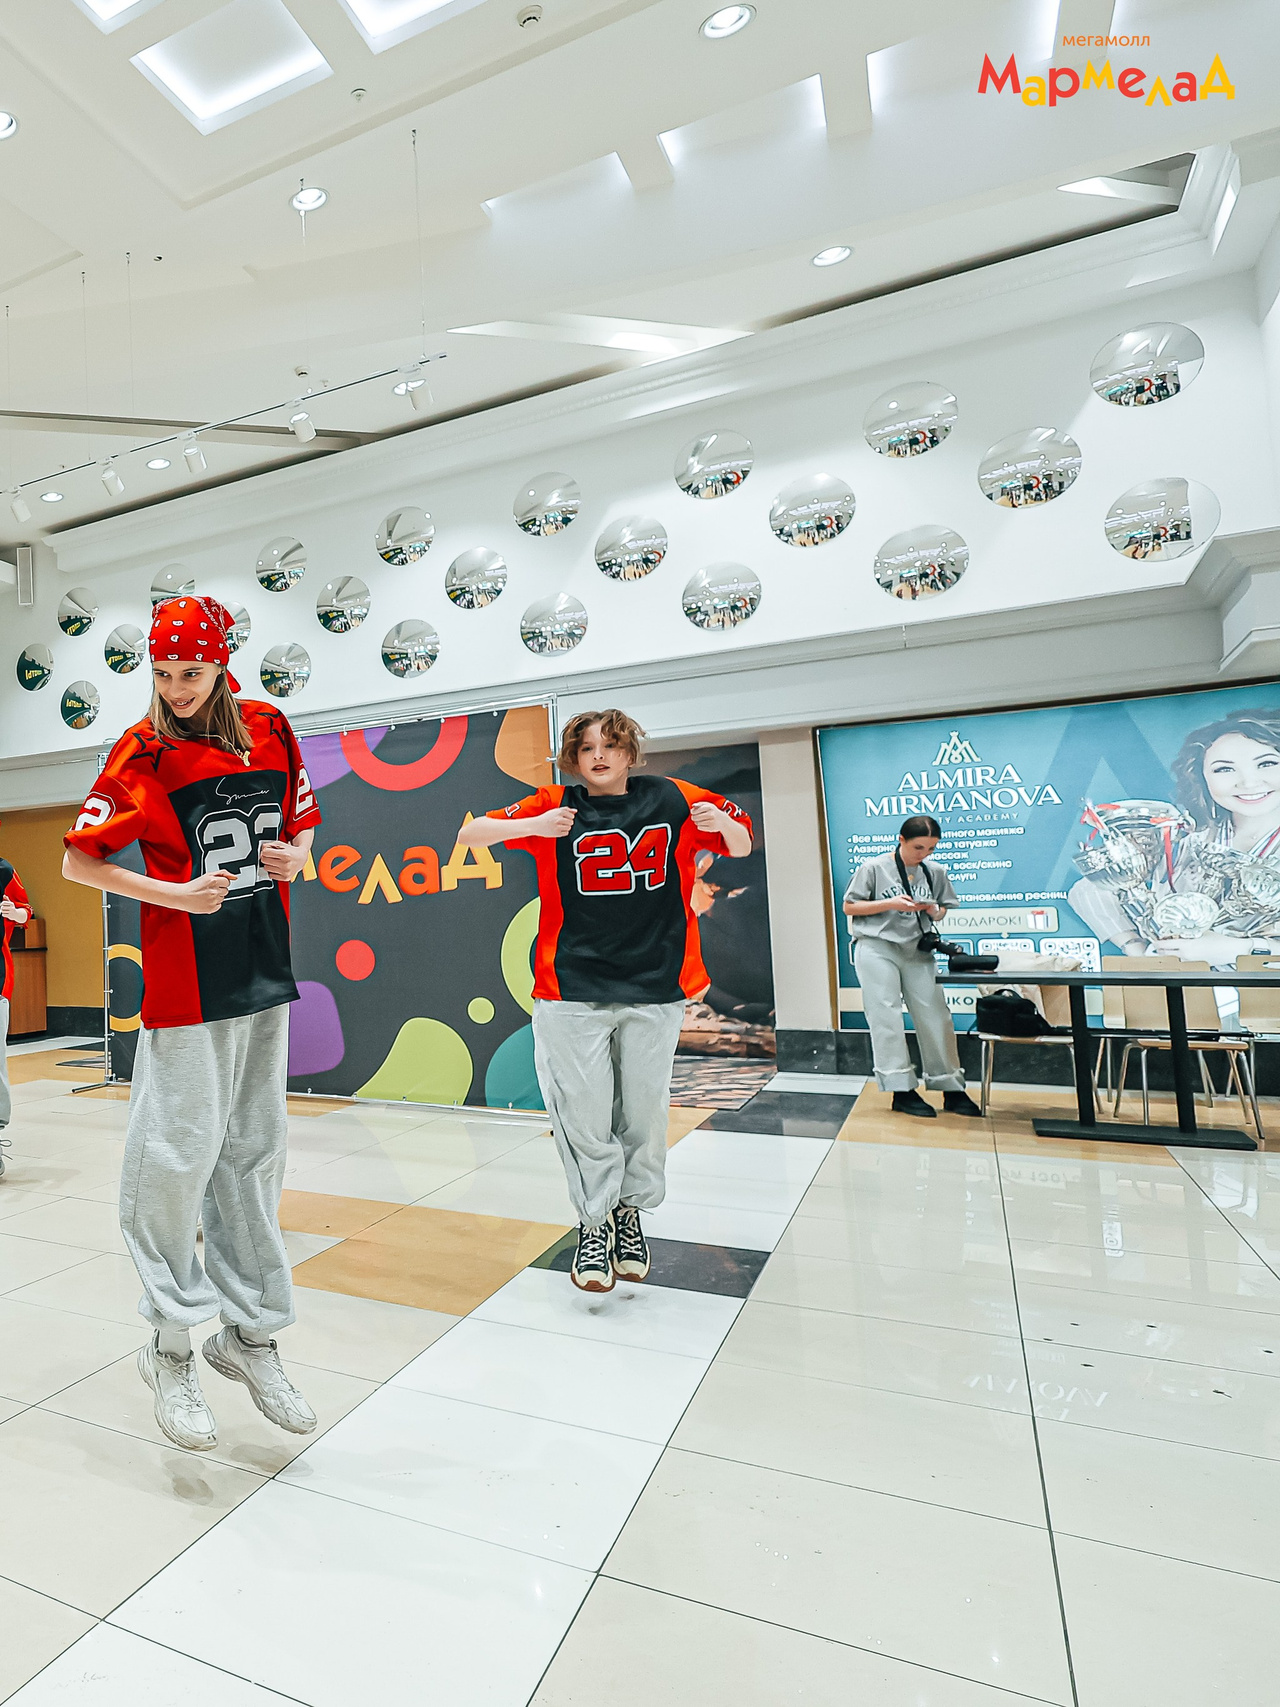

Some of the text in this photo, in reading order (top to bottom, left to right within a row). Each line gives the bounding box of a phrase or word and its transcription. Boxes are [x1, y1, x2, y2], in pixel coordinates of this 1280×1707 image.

[897, 763, 1023, 793] ALMIRA
[864, 784, 1063, 817] MIRMANOVA
[958, 812, 1020, 824] ACADEMY
[954, 839, 998, 850] татуажа
[572, 823, 672, 896] 24
[1024, 891, 1067, 902] ресниц
[948, 915, 1022, 927] ПОДАРОК!
